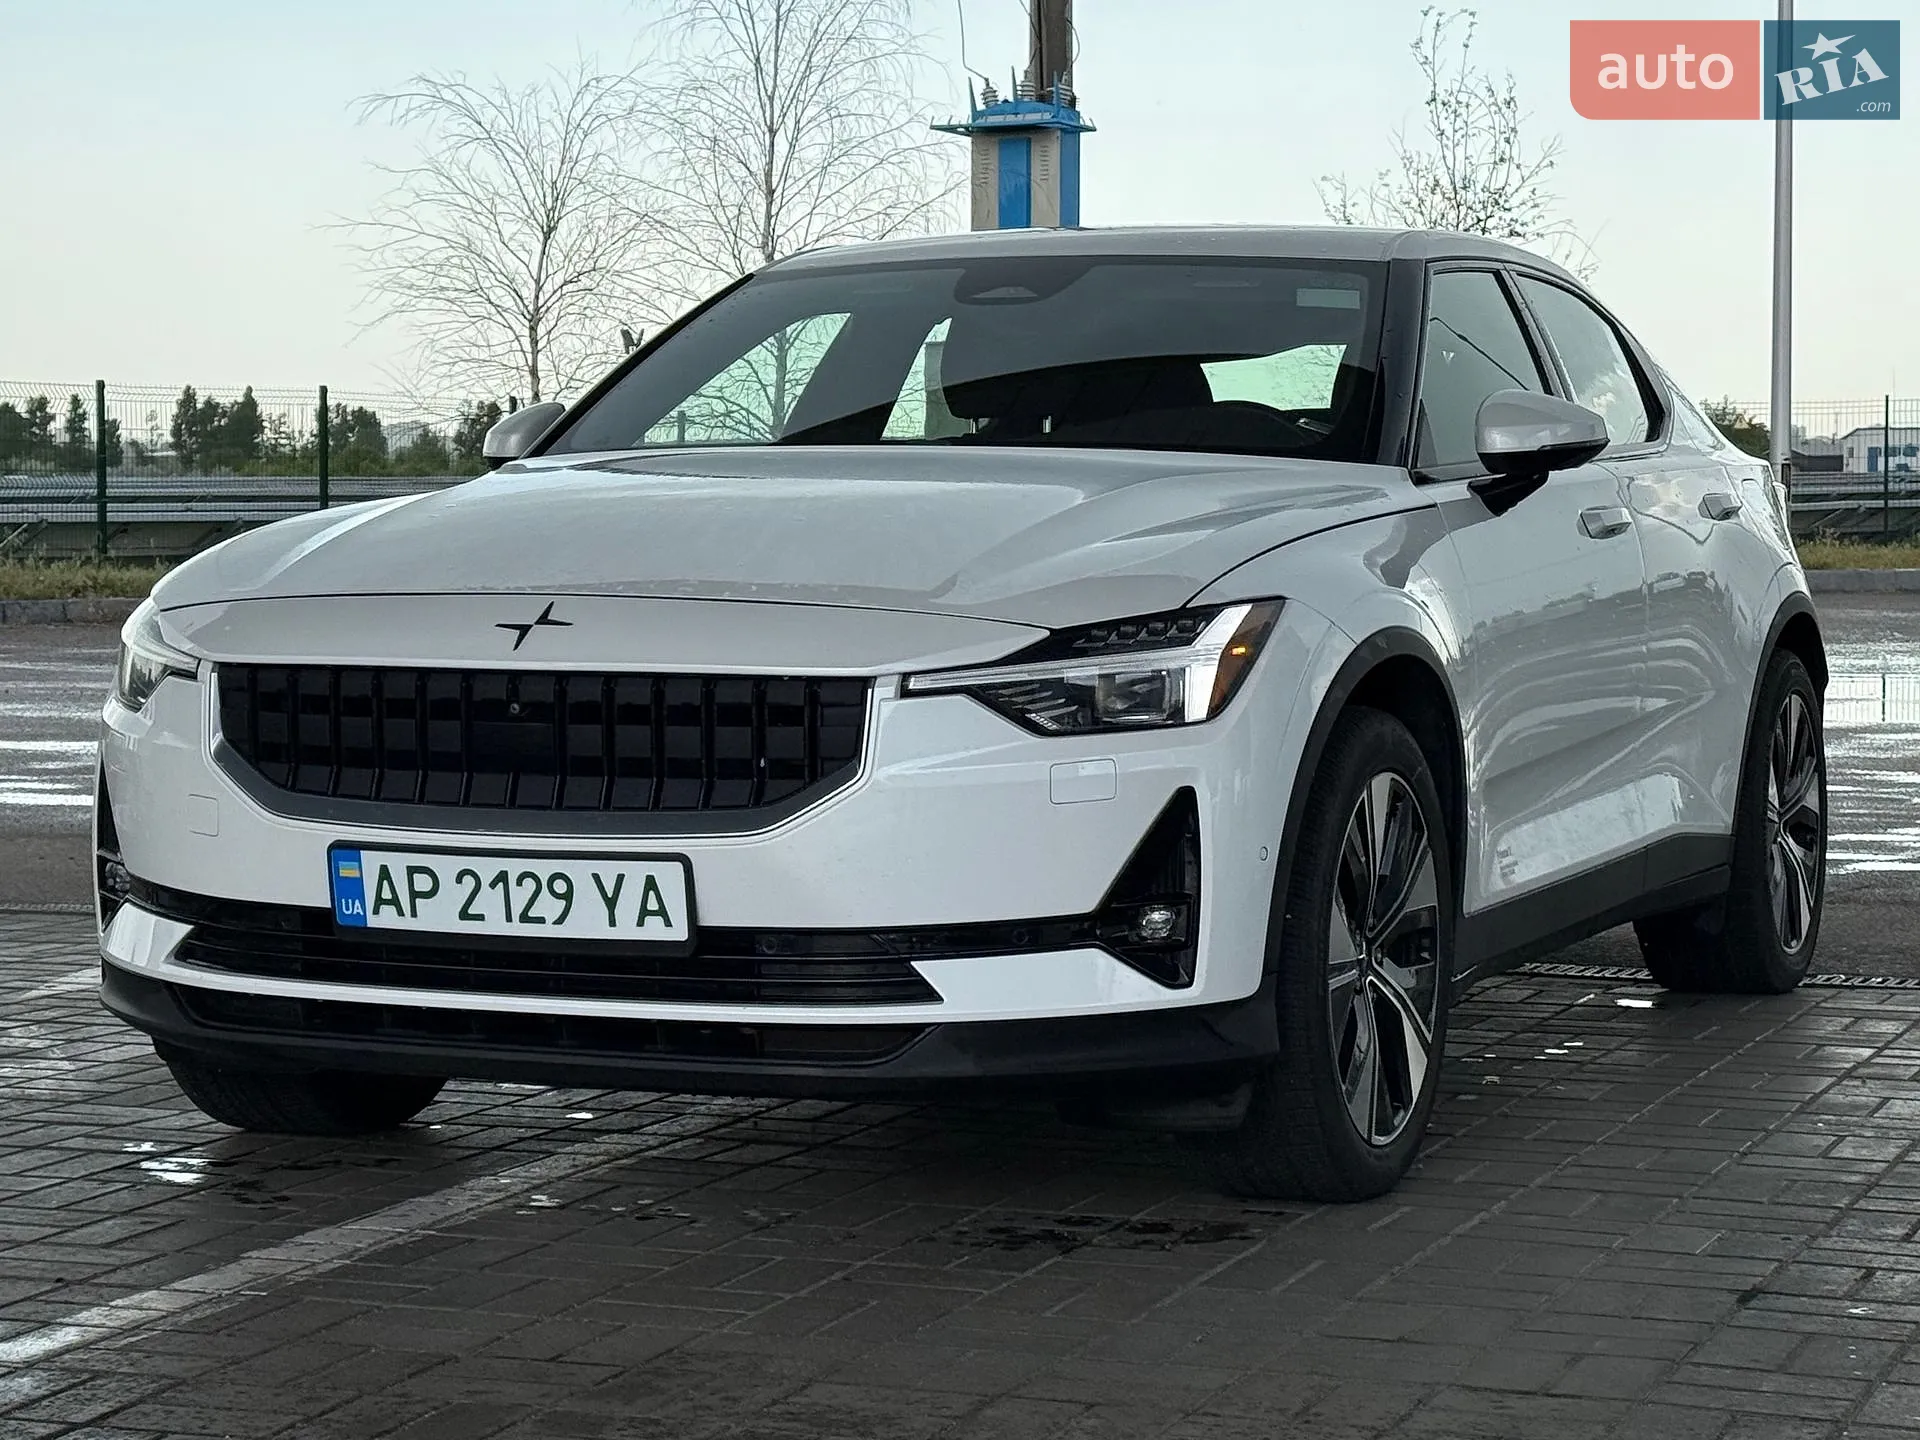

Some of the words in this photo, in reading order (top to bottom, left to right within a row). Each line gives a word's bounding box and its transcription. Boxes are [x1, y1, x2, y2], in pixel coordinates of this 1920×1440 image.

[341, 898, 365, 917] UA
[372, 863, 441, 918] AP
[455, 868, 575, 925] 2129
[591, 872, 673, 928] YA
